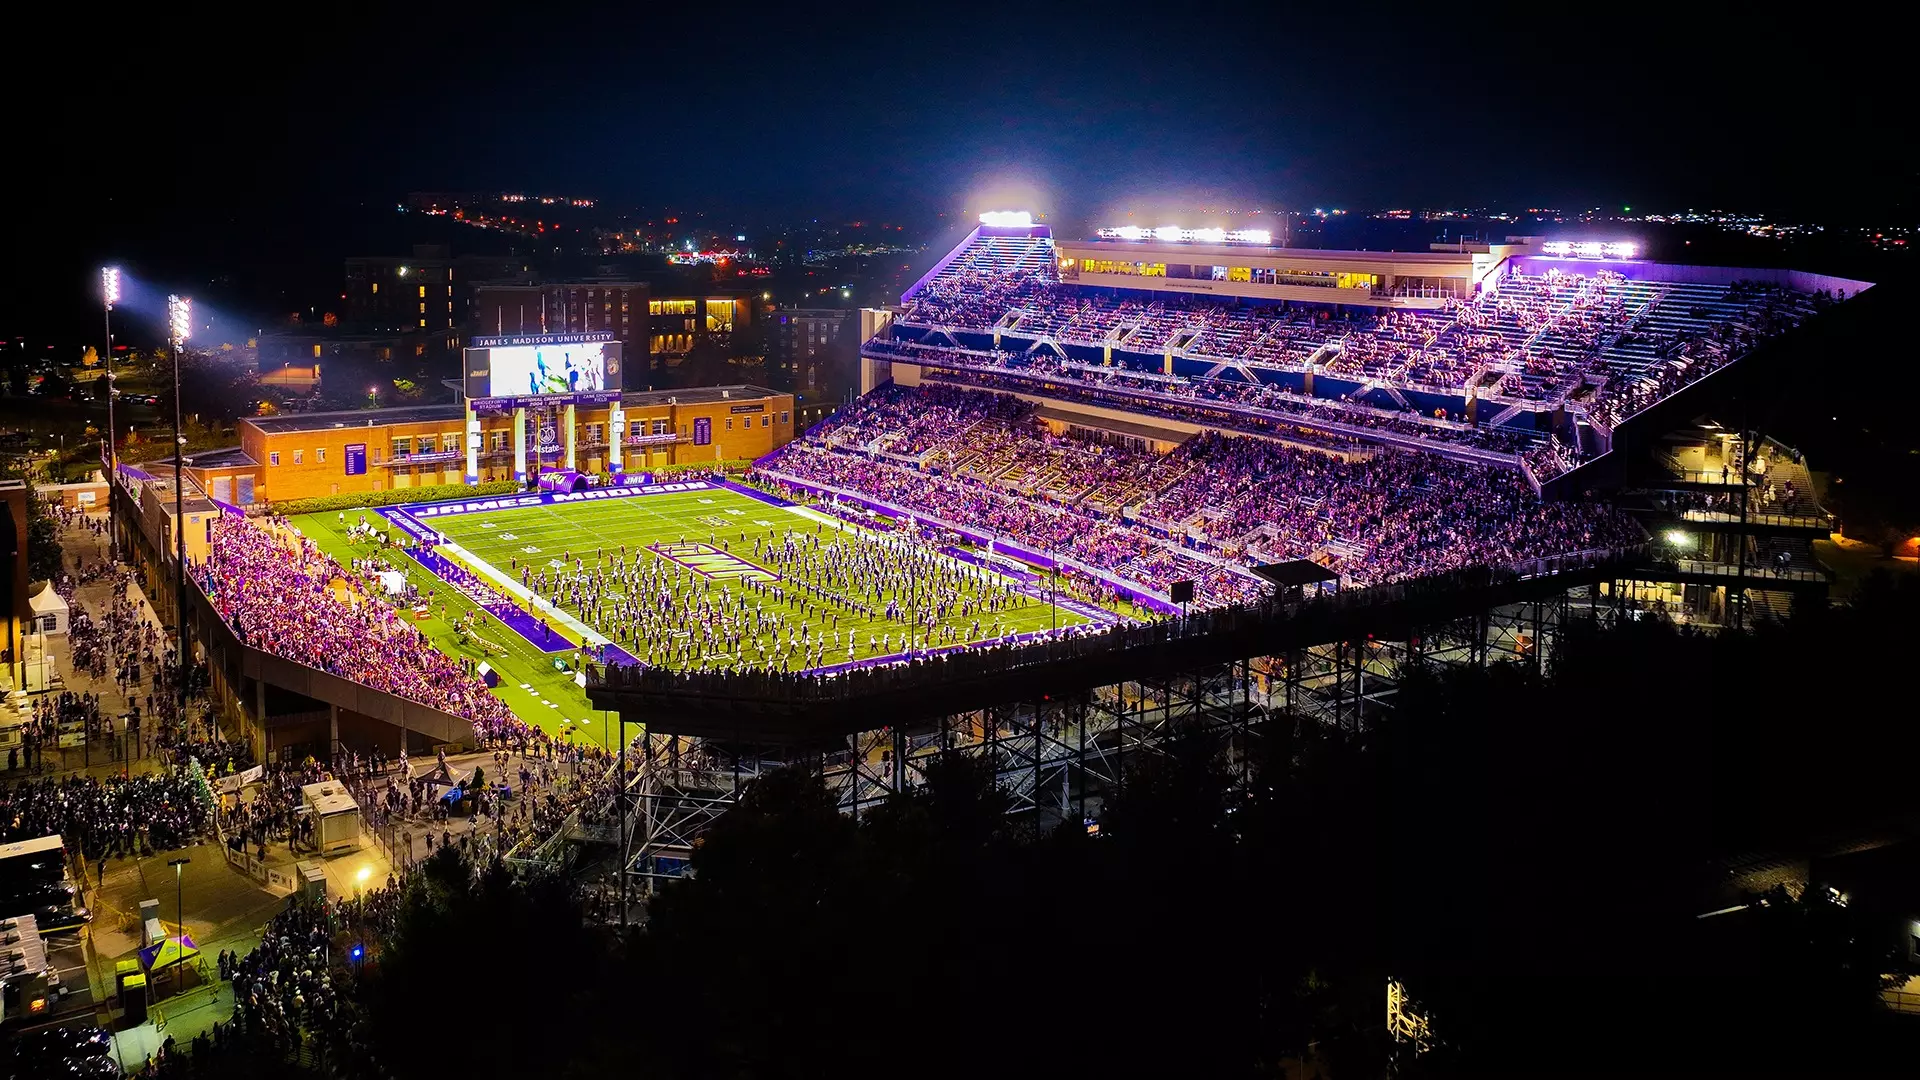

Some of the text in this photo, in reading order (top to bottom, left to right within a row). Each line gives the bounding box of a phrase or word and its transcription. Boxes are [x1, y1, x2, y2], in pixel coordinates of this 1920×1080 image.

[479, 333, 612, 346] JAMES MADISON UNIVERSITY
[531, 444, 560, 453] Alstate
[624, 475, 645, 485] JMU
[414, 481, 709, 516] JAMES MADISON
